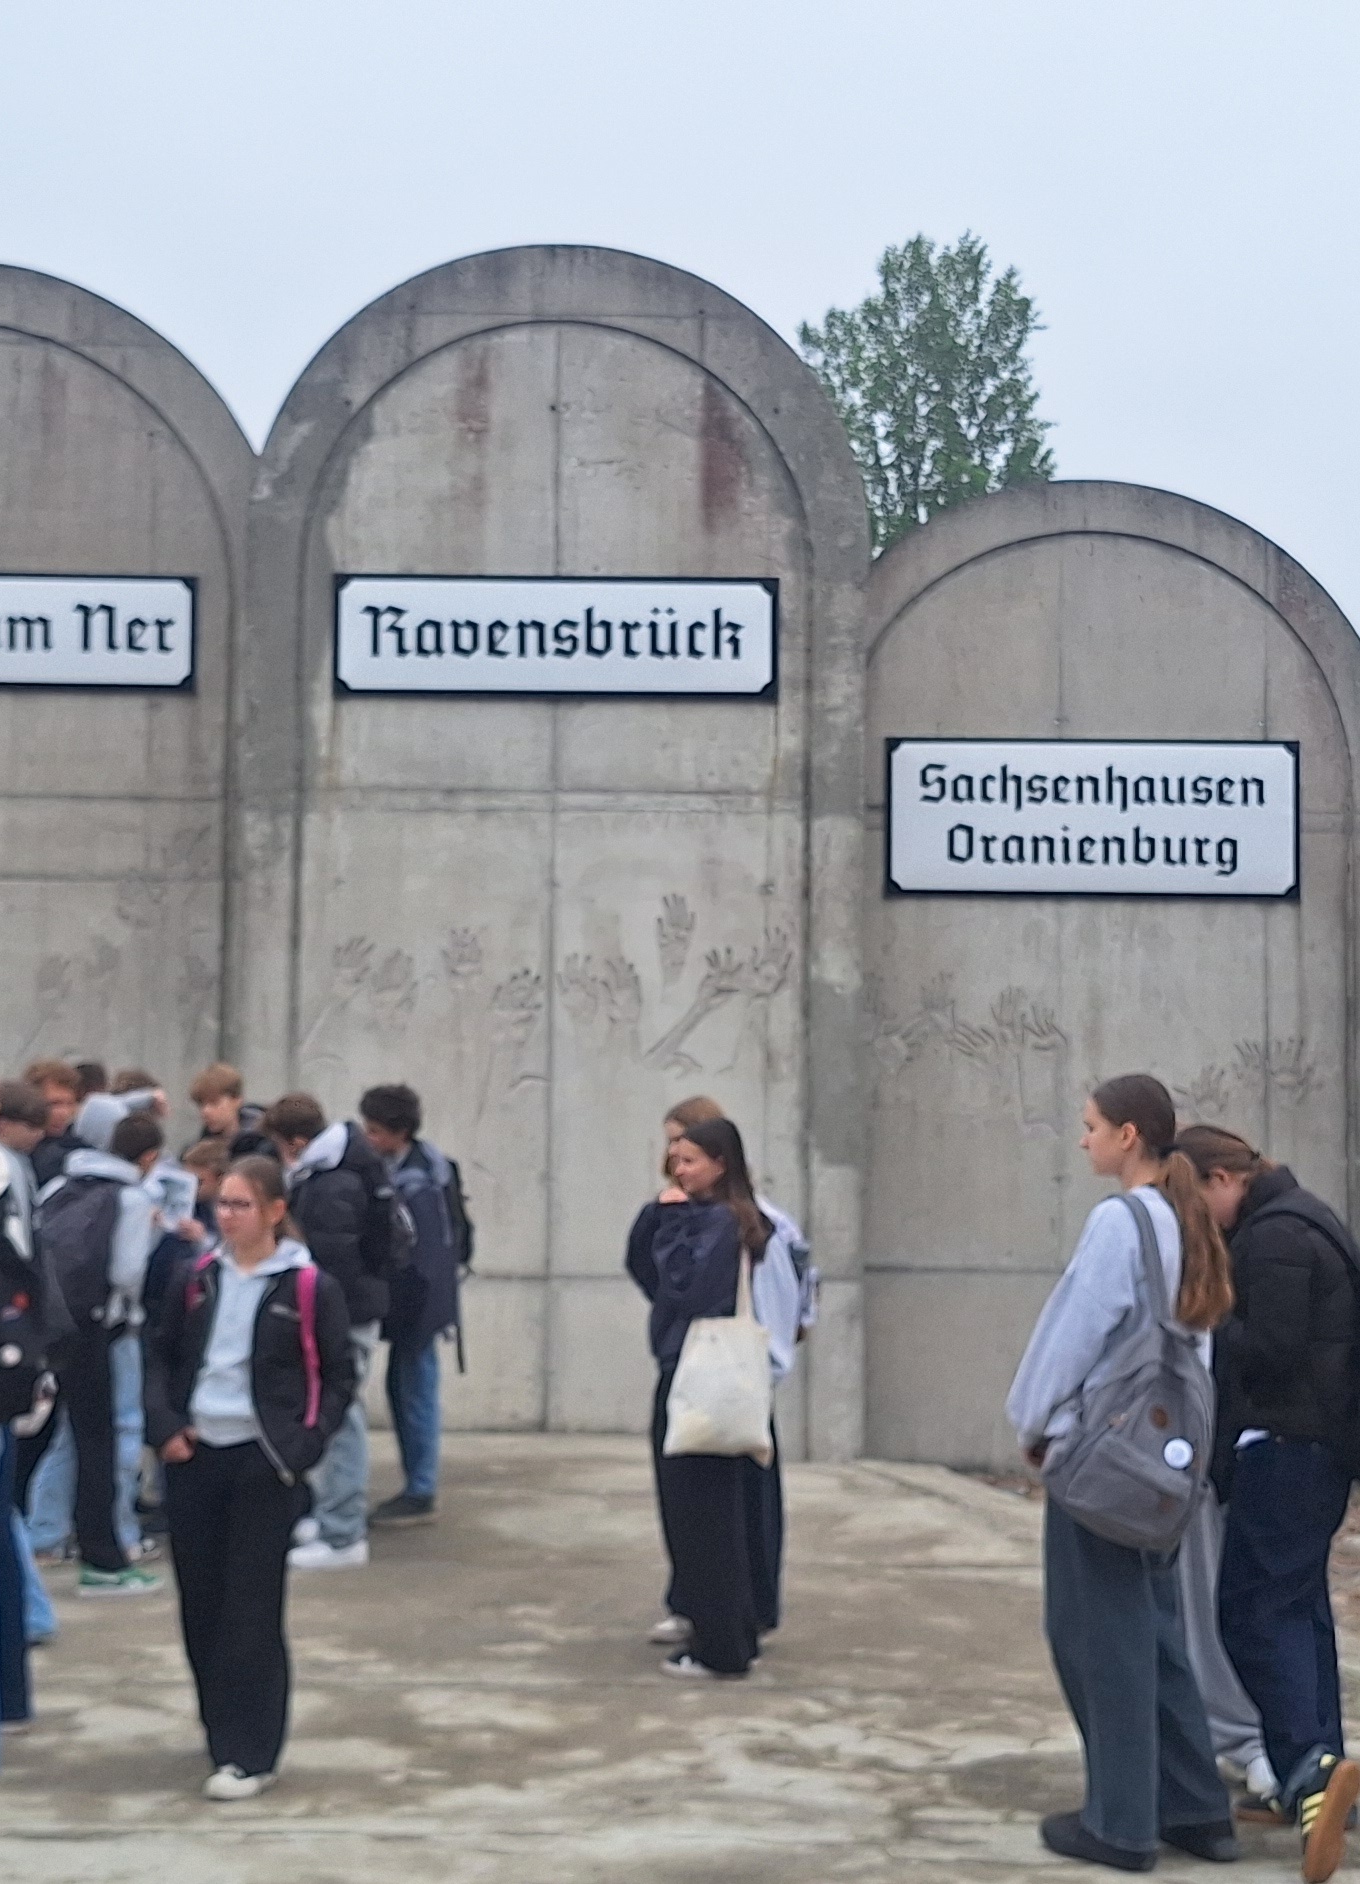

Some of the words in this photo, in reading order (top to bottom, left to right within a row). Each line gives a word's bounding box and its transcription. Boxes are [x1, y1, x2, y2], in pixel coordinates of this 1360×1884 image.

[70, 602, 177, 656] Ner
[360, 604, 746, 661] Ravensbrück
[918, 762, 1268, 813] Sachsenhausen
[945, 822, 1240, 878] Oranienburg
